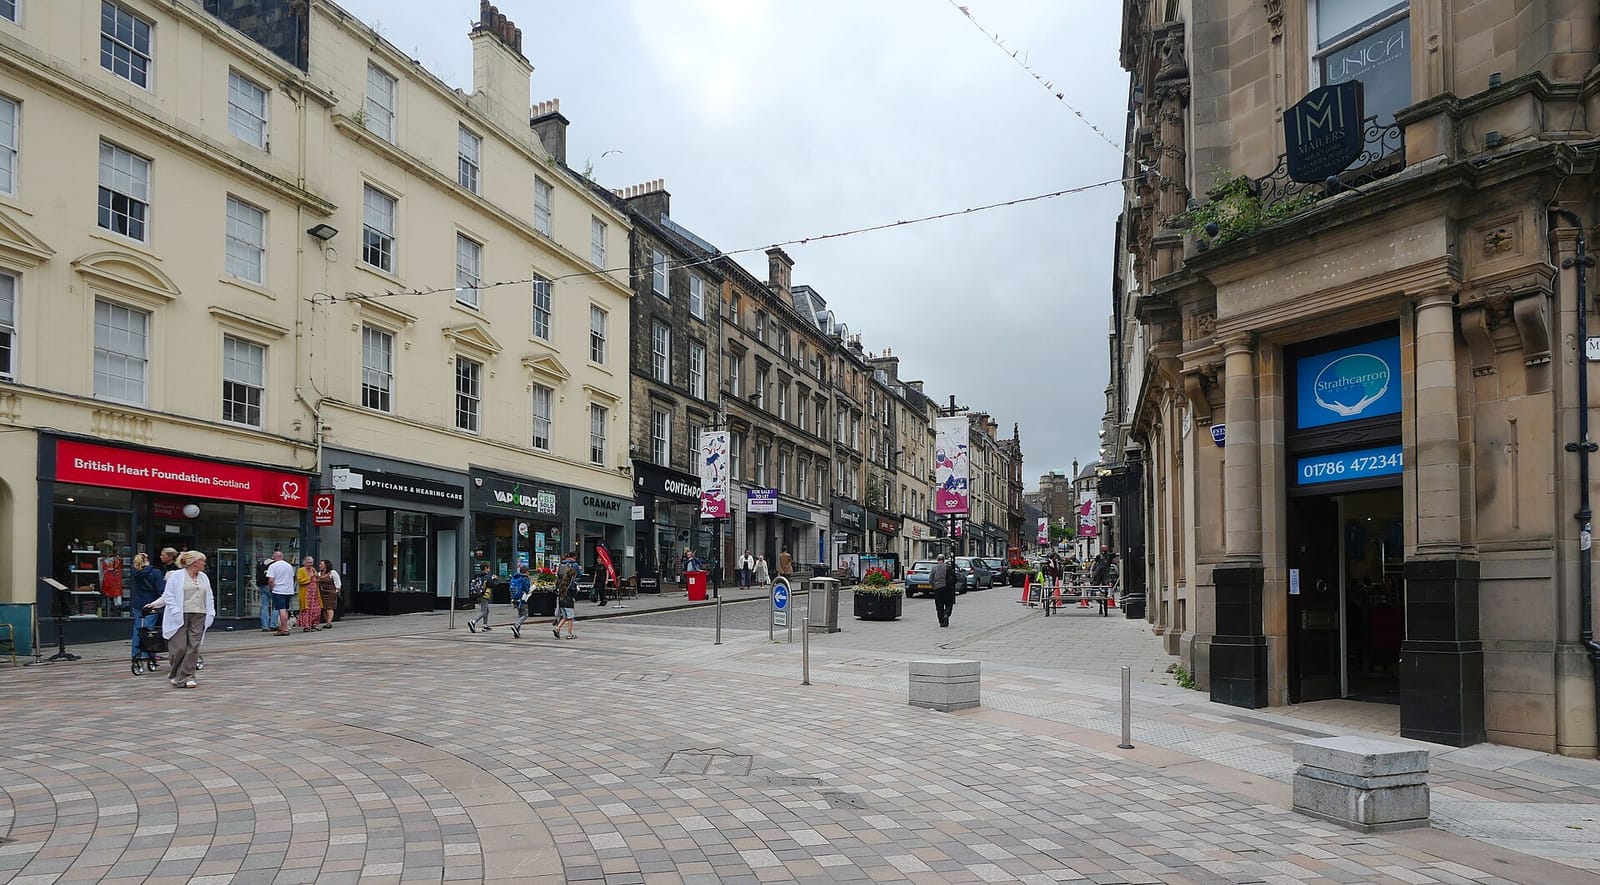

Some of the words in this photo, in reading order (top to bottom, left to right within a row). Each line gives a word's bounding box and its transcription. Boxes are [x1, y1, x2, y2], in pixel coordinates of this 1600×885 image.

[1330, 31, 1404, 81] UNICA
[1298, 128, 1345, 156] MAILERS
[1318, 370, 1387, 391] Strathcarron
[74, 458, 115, 473] British
[117, 464, 150, 477] Heart
[152, 468, 210, 485] Foundation
[212, 476, 251, 490] Scotland
[1303, 460, 1345, 478] 01786
[1350, 452, 1404, 472] 472341
[365, 479, 409, 492] OPTICIANS
[410, 485, 416, 493] &
[416, 487, 446, 499] HEARING
[446, 491, 464, 501] CARE
[493, 489, 538, 508] VAPOURZ
[539, 493, 554, 504] CBD
[583, 495, 622, 511] GRANARY
